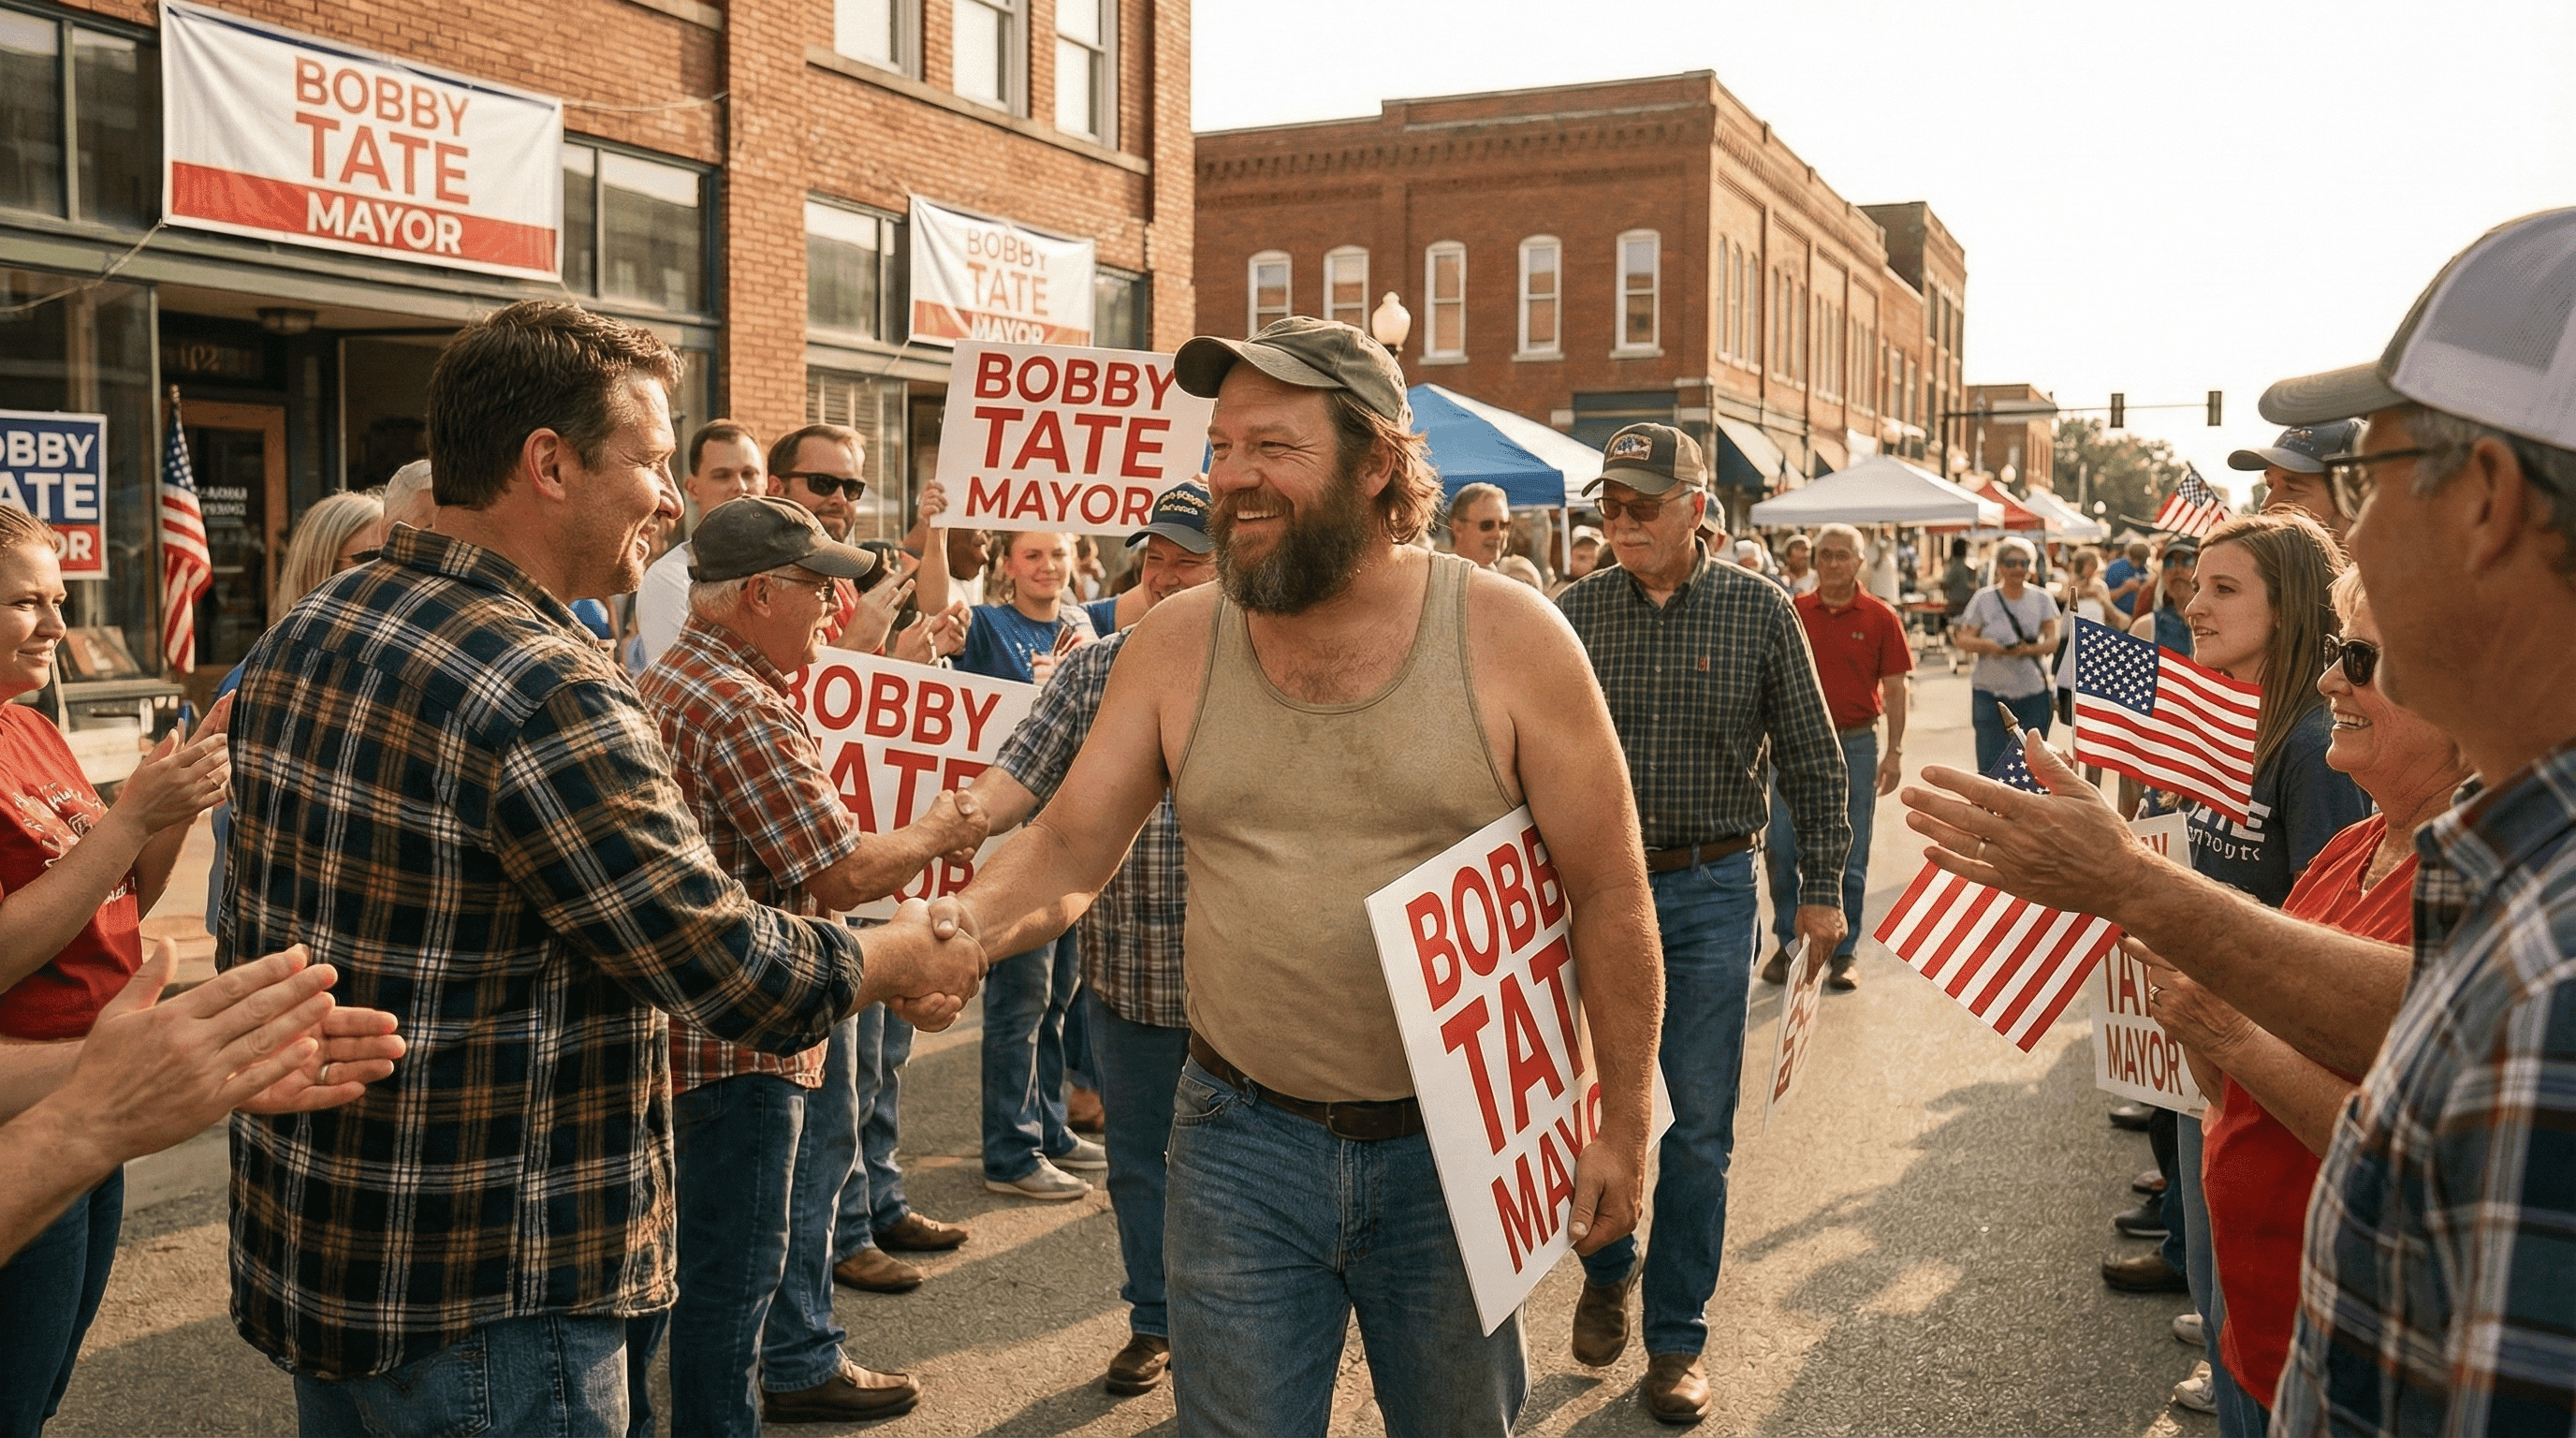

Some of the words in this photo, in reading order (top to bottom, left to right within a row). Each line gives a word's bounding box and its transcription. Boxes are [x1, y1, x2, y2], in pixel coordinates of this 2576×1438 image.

[295, 55, 470, 137] BOBBY
[295, 110, 470, 205] TATE
[307, 191, 463, 255] MAYOR
[967, 227, 1046, 271] BOBBY
[967, 260, 1048, 316] TATE
[974, 352, 1177, 410] BOBBY
[0, 431, 95, 468] BBY
[974, 405, 1171, 478] TATE
[965, 477, 1155, 526] MAYOR
[2106, 1023, 2184, 1096] MAYOR
